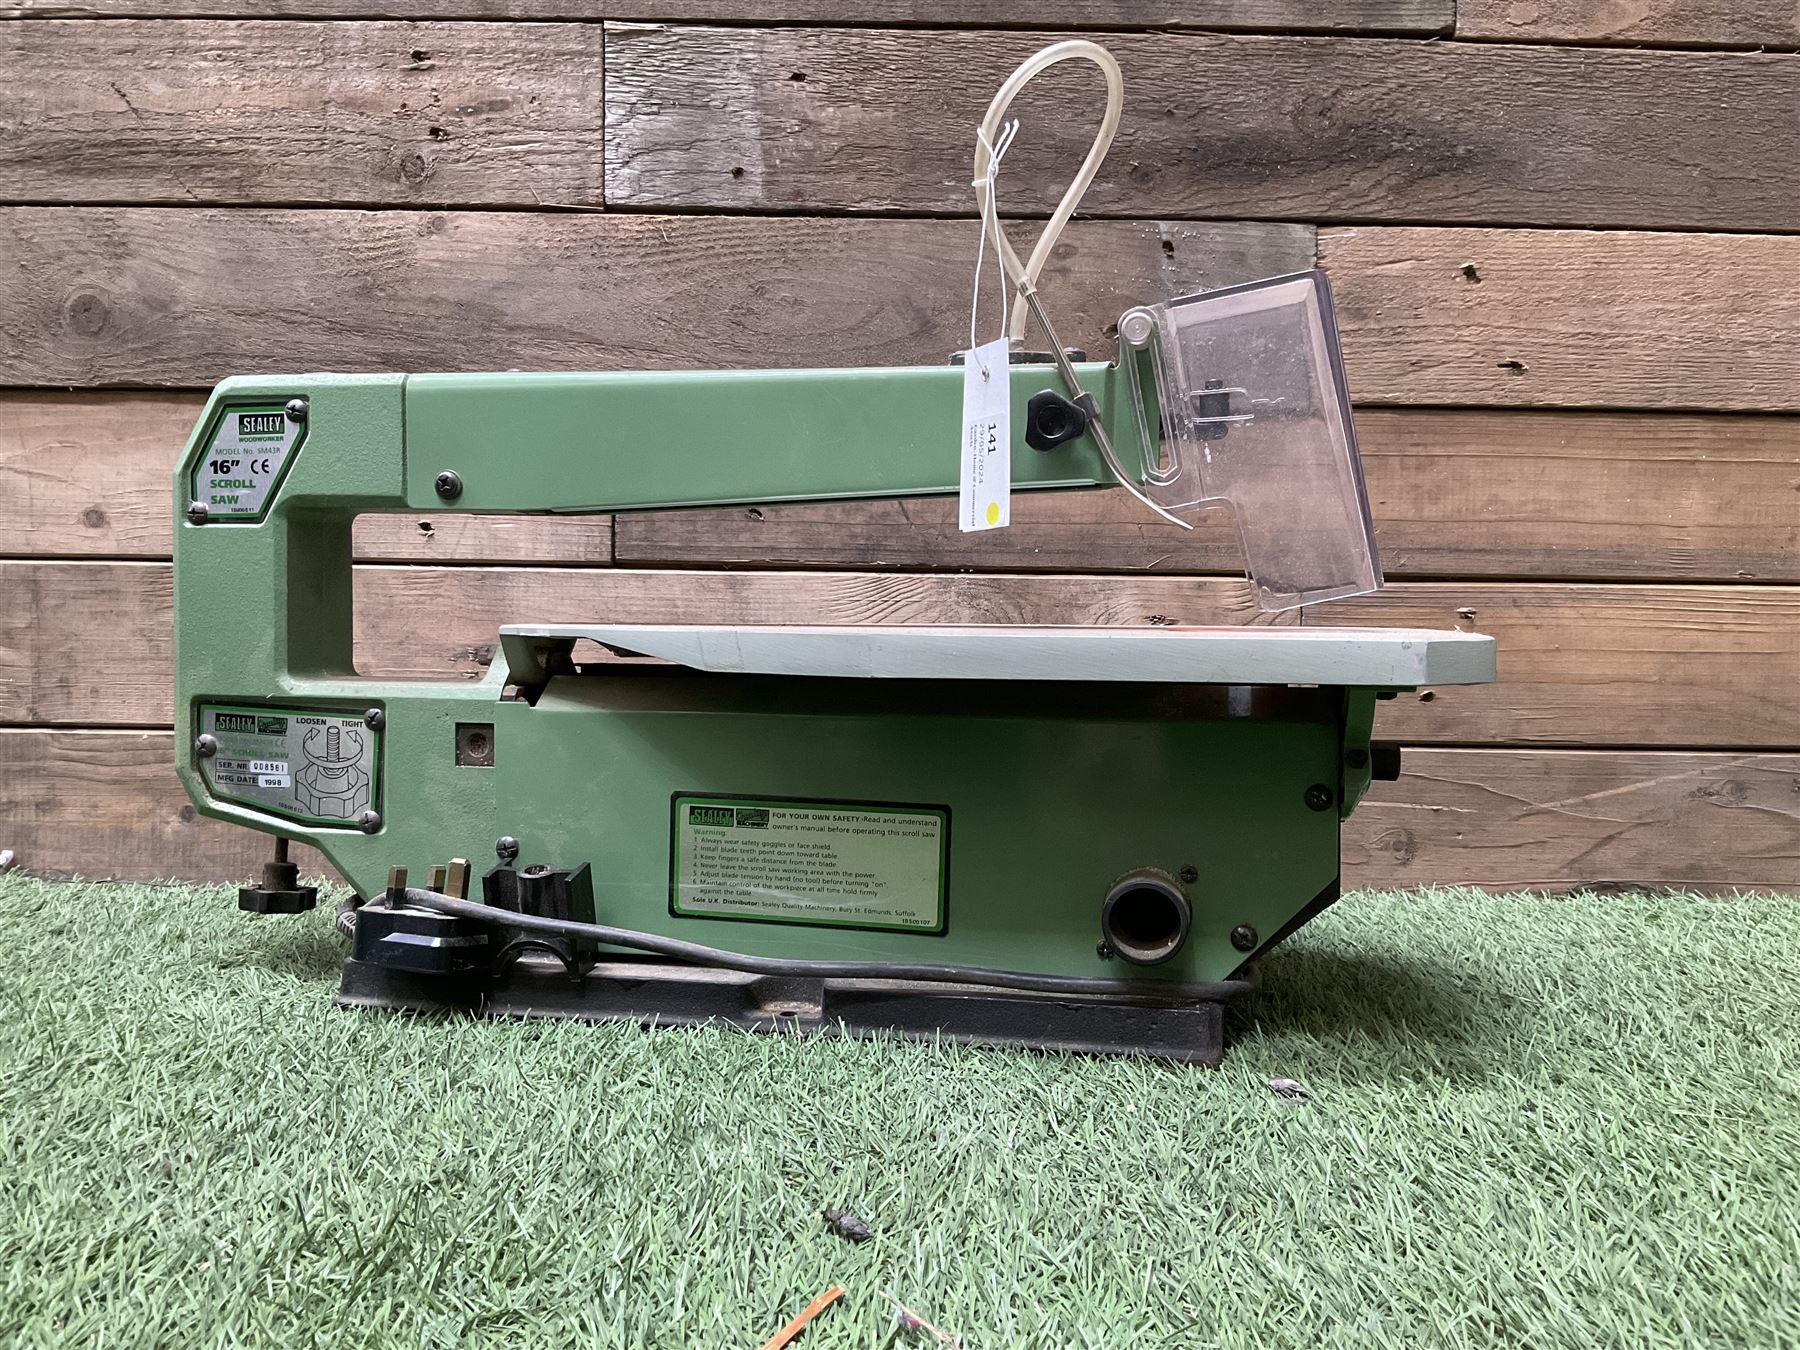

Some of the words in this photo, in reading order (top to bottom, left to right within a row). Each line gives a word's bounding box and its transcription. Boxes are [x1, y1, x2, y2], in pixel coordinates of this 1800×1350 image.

[244, 417, 280, 432] SEALEY
[988, 424, 996, 456] 141
[210, 480, 256, 488] SCROLL
[211, 496, 239, 504] SAW
[220, 716, 252, 732] SEALEY
[296, 717, 326, 725] LOOSEN
[694, 808, 732, 826] SEALEY
[898, 818, 937, 827] understand
